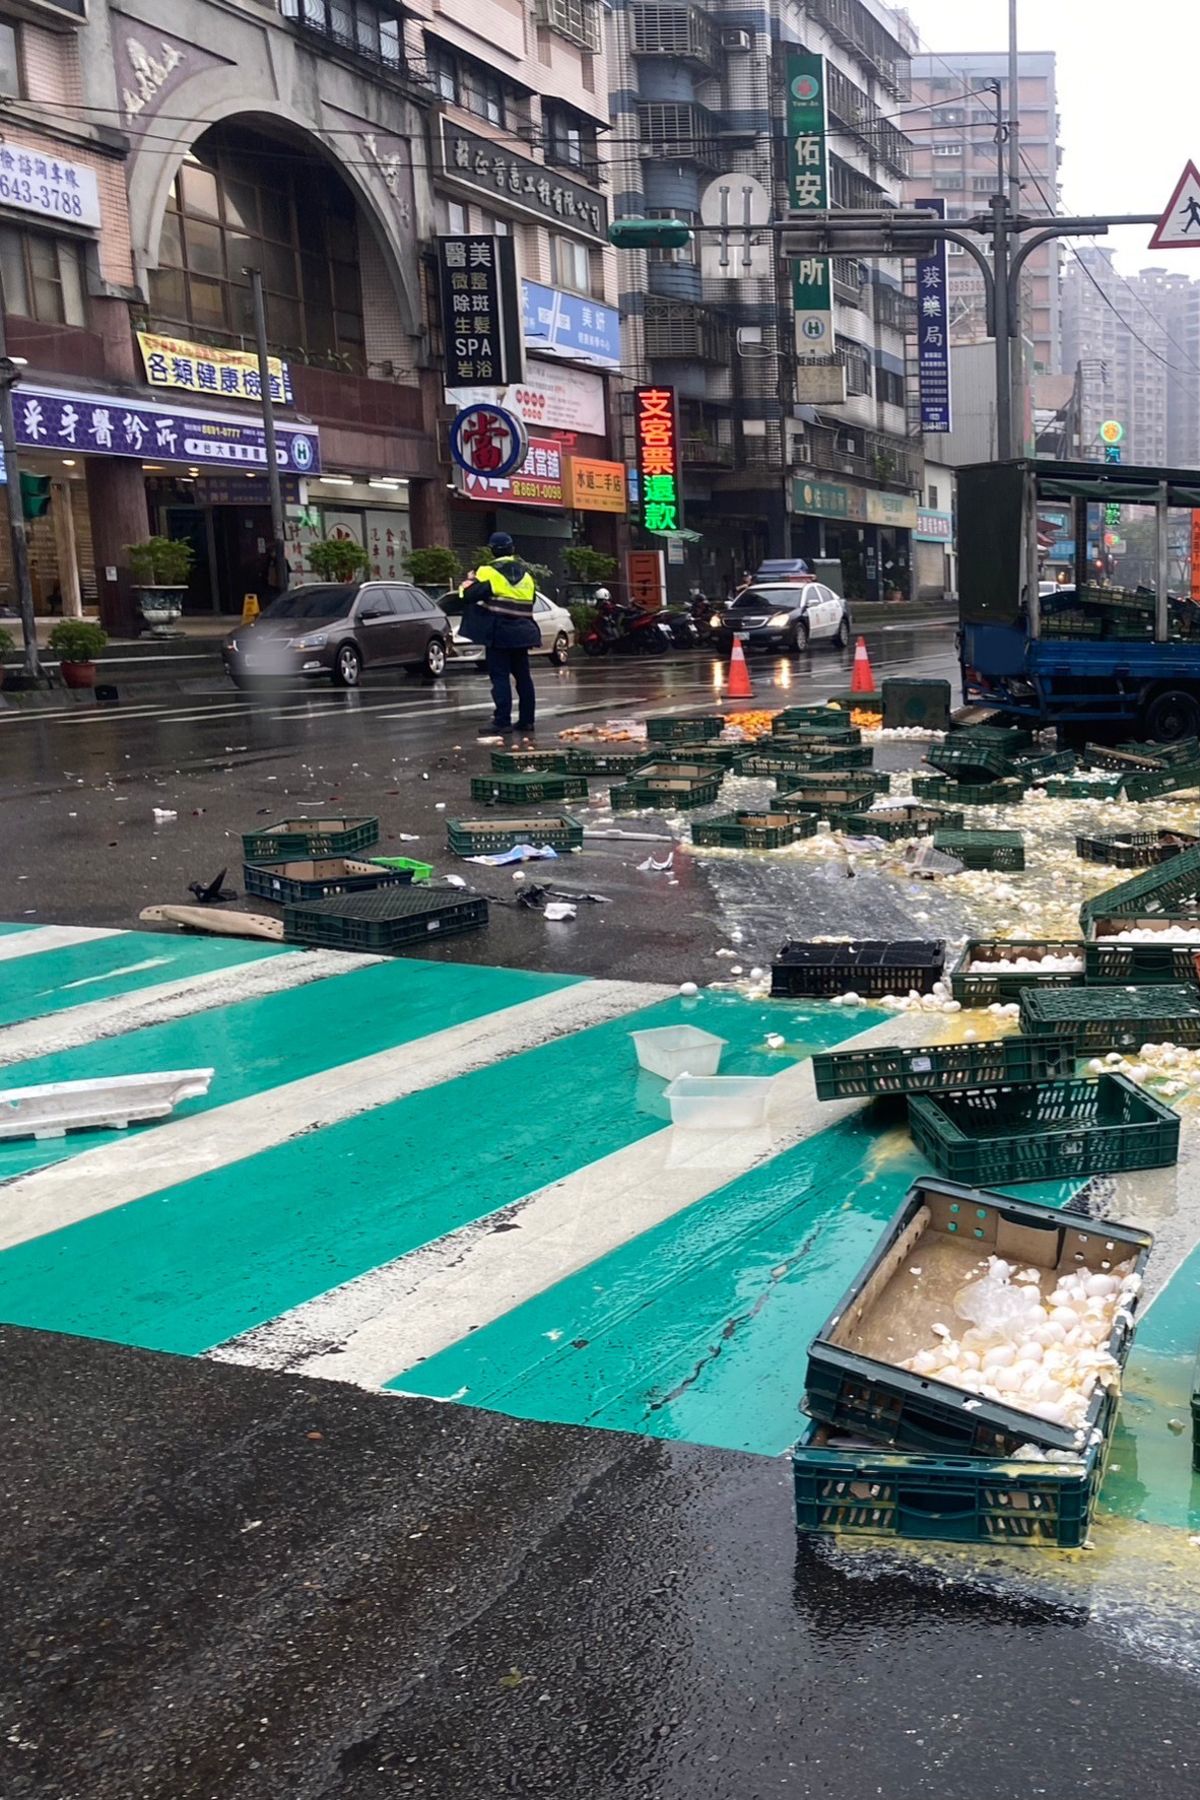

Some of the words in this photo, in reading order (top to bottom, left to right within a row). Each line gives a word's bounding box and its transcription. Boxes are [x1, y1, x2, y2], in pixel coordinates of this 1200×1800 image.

[445, 241, 493, 268] 醫美
[451, 272, 488, 290] 微整
[453, 294, 490, 312] 除斑
[455, 316, 491, 335] 生髮
[456, 338, 492, 356] SPA
[148, 352, 283, 399] 各類健康檢查
[458, 361, 493, 379] 岩浴
